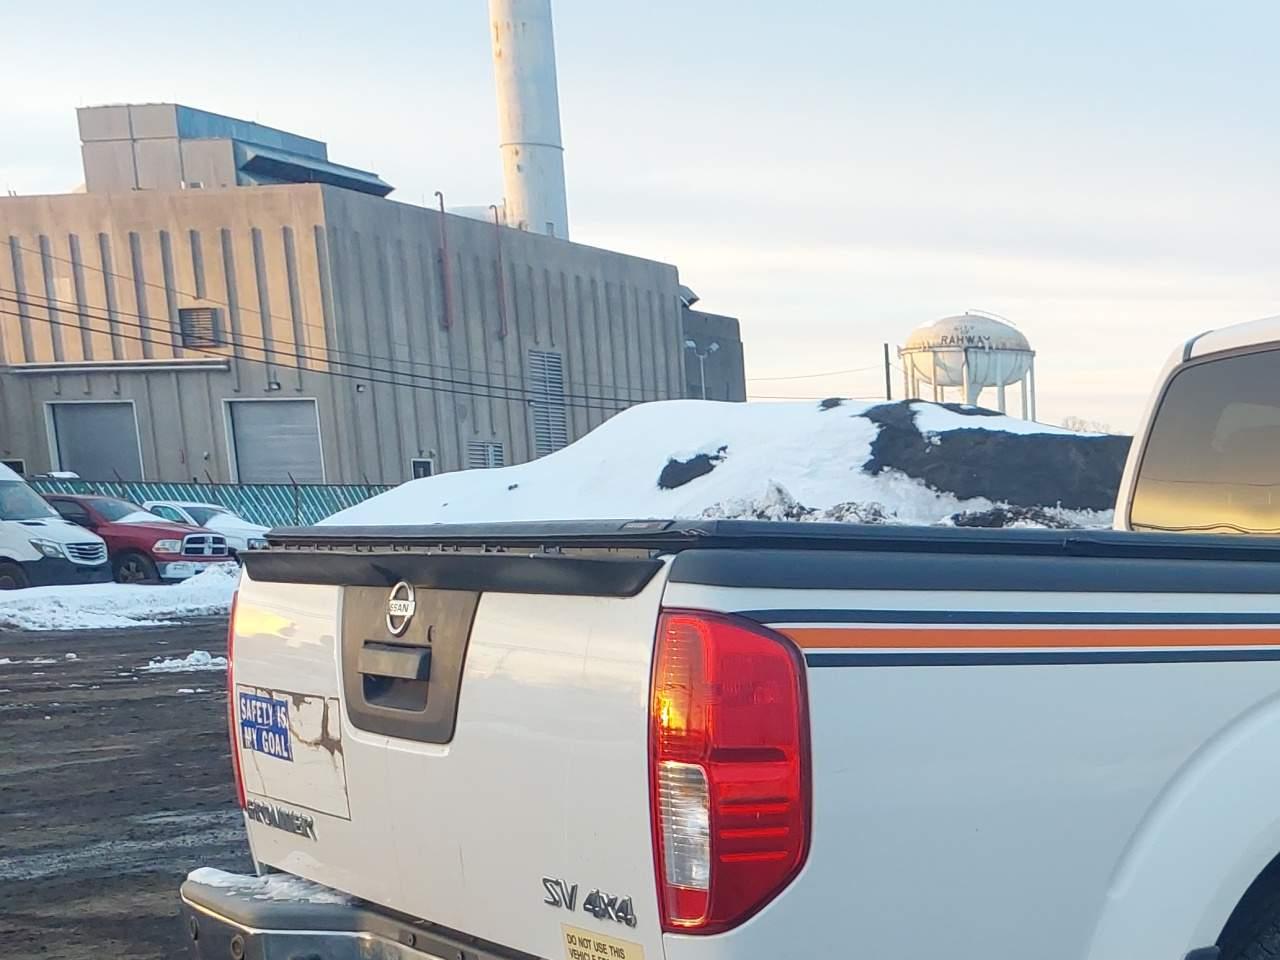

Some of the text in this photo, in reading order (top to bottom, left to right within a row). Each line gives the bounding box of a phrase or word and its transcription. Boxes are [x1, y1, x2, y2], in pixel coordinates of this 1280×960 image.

[941, 335, 991, 345] RAHWAY
[241, 697, 287, 728] SAFETY IS
[262, 730, 289, 758] GOAL
[542, 876, 578, 912] SV
[566, 933, 626, 960] DO NOT USE THIS
